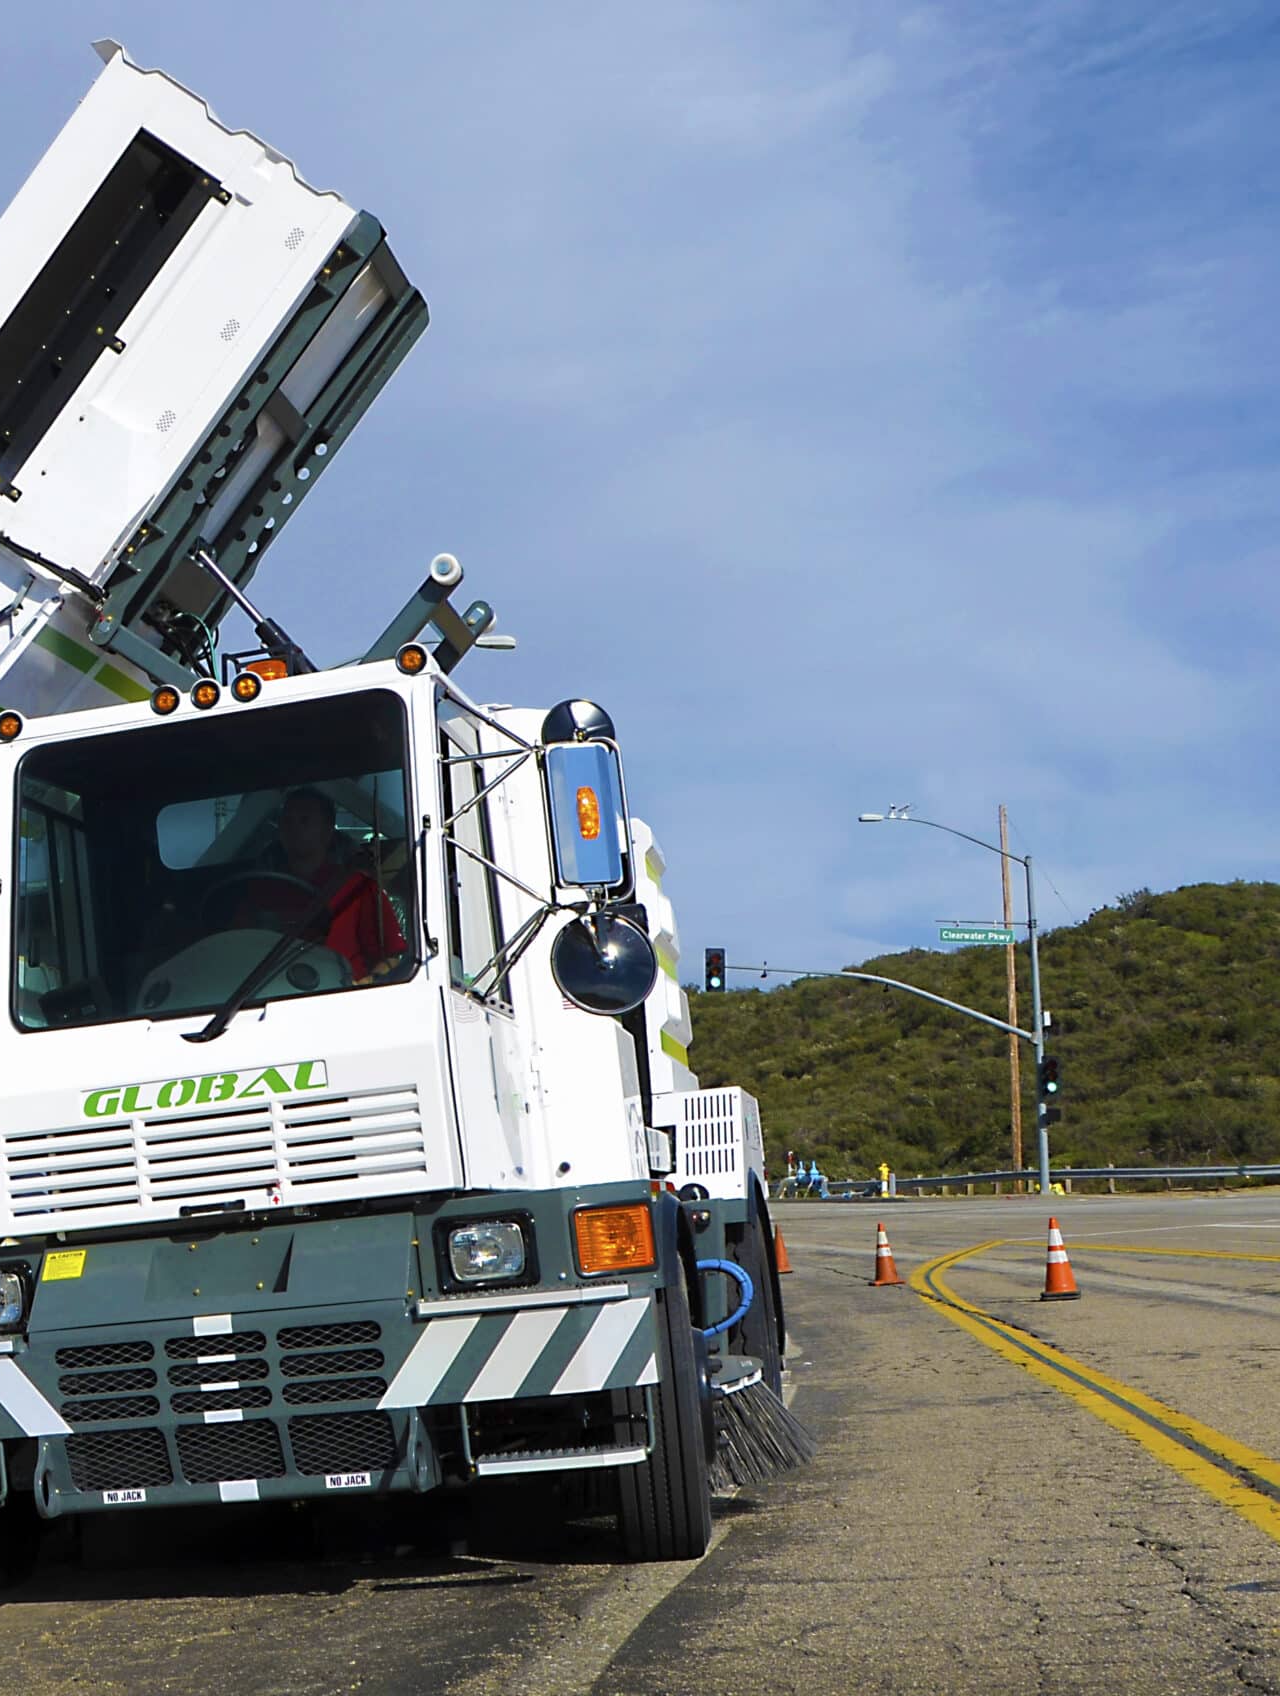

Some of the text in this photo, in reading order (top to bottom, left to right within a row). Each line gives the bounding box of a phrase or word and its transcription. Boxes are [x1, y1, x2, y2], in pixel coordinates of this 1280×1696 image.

[942, 930, 1010, 942] Clearwater Pkwy
[83, 1061, 327, 1118] GLOBAL
[329, 1474, 367, 1486] NO JACK
[107, 1491, 142, 1502] NO JACK
